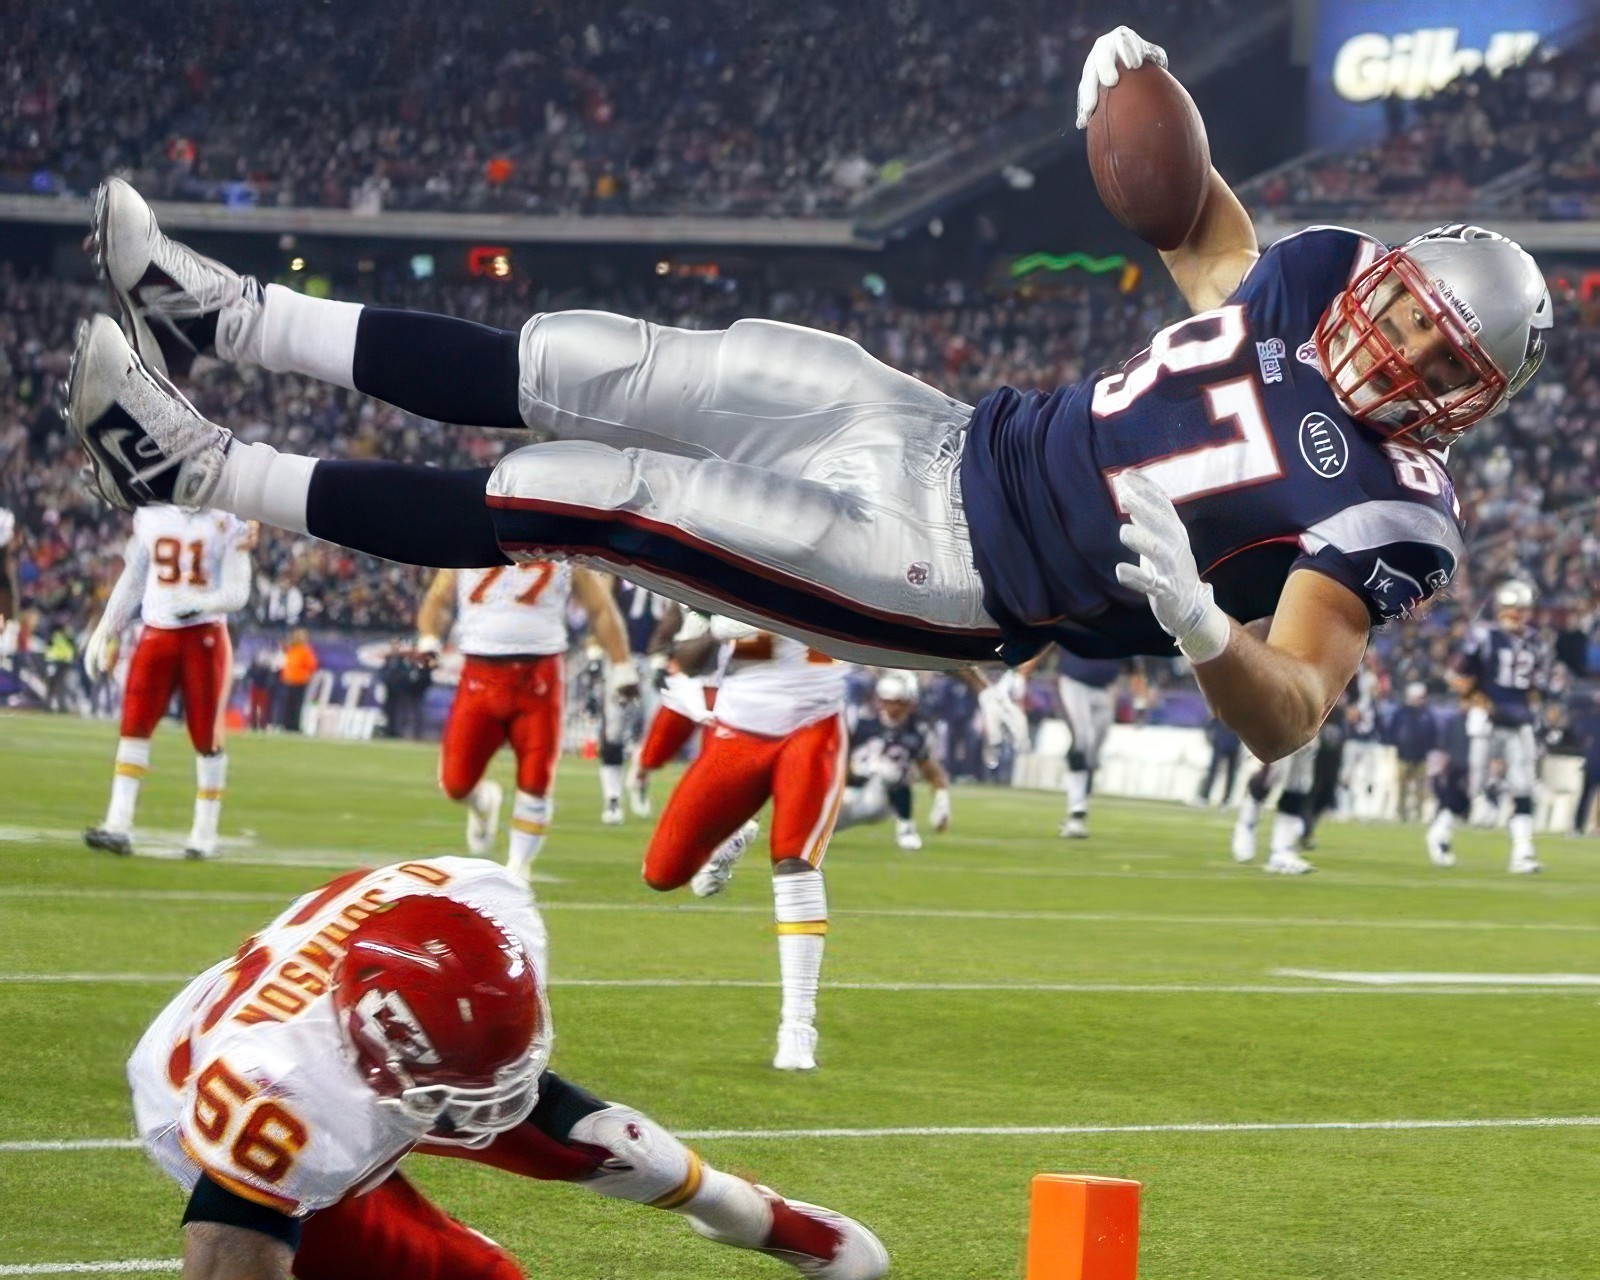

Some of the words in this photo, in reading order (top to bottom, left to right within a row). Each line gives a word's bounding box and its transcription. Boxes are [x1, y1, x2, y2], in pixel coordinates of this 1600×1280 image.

[1090, 304, 1287, 522] 87
[1307, 420, 1340, 471] MHK
[154, 536, 208, 588] 91
[194, 1057, 309, 1183] 56
